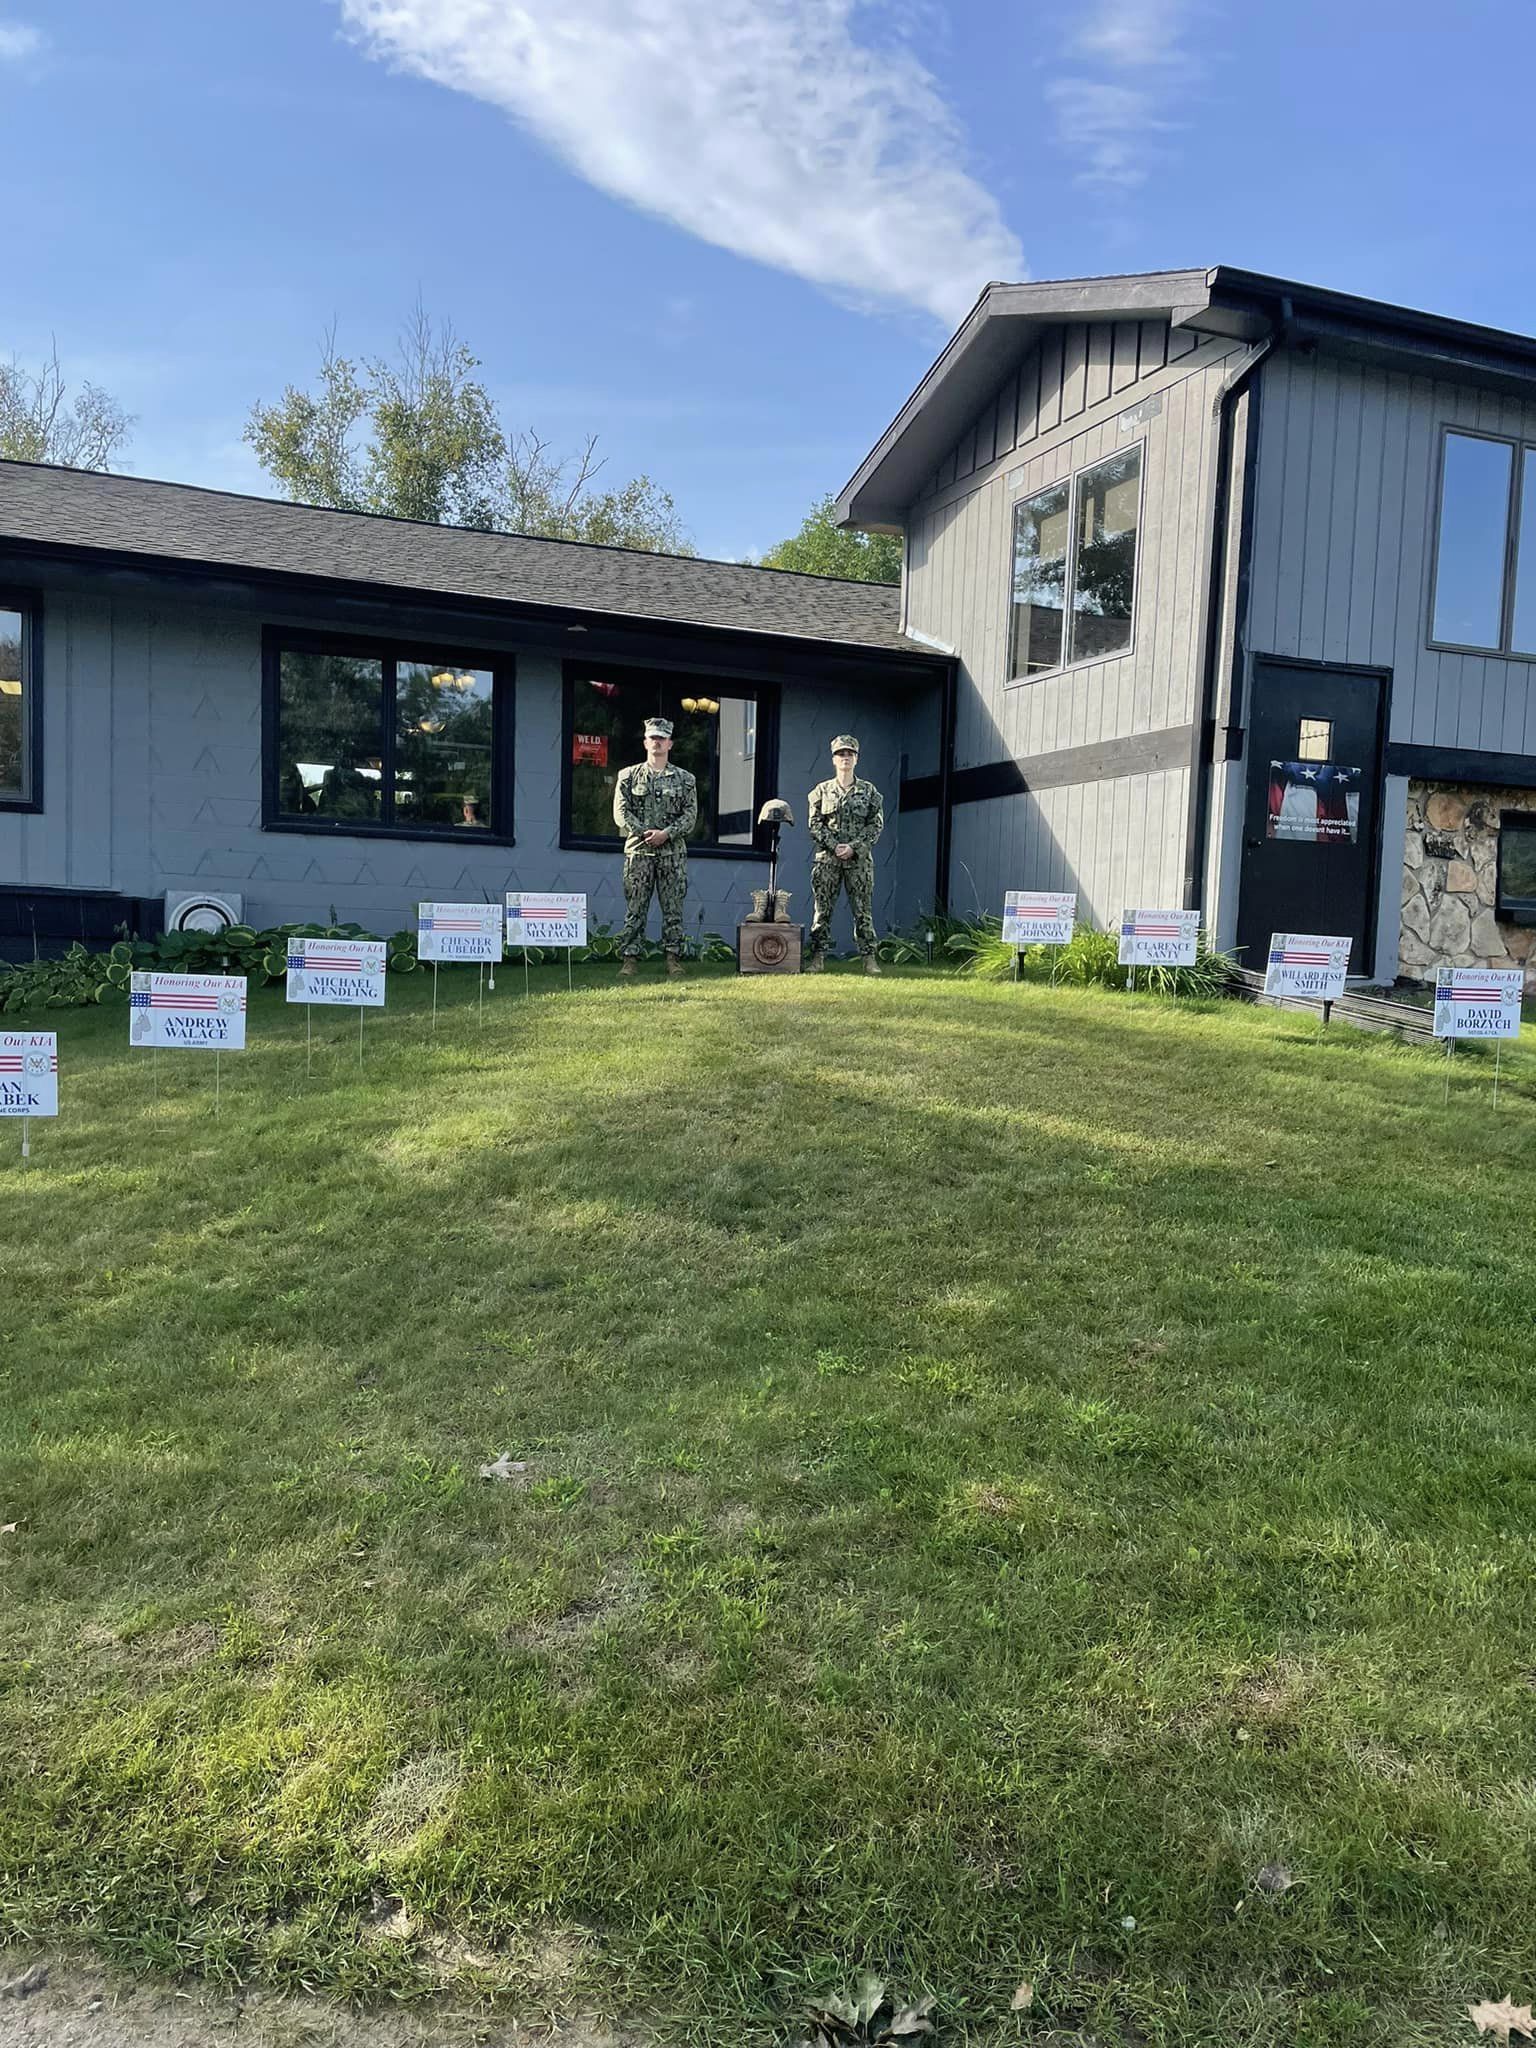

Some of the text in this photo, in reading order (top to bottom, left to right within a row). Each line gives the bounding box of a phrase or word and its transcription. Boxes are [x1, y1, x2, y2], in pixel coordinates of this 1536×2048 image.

[577, 734, 590, 744] WE
[1269, 814, 1297, 822] Freedom
[1304, 816, 1320, 824] most
[1321, 818, 1356, 827] appreciated
[523, 896, 554, 904] Honoring
[1020, 895, 1048, 903] Honoring
[436, 906, 468, 915] Honoring
[470, 906, 483, 914] Our
[1138, 912, 1198, 921] Honoring Our KIA
[526, 922, 578, 930] PVT ADAM
[1032, 922, 1062, 930] HARVEY
[441, 936, 492, 946] CHESTER
[1288, 936, 1350, 948] Honoring Our KIA
[308, 942, 348, 953] Honoring
[441, 945, 492, 954] LUBERDA
[1137, 942, 1192, 951] CLARENCE
[1146, 951, 1179, 959] SANTY
[1282, 970, 1343, 981] WILLARD JESSE
[1456, 972, 1490, 982] Honoring
[1491, 973, 1505, 981] Our
[154, 976, 243, 989] Honoring Our KIA
[314, 977, 372, 988] MICHAEL
[1295, 981, 1328, 990] SMITH
[308, 986, 378, 998] WENDLING
[1468, 1009, 1502, 1019] DAVID
[164, 1017, 229, 1028] ANDREW
[1457, 1019, 1511, 1029] BORZYCH
[165, 1027, 228, 1039] WALACE
[4, 1036, 52, 1046] Our KIA
[0, 1094, 40, 1106] BEK
